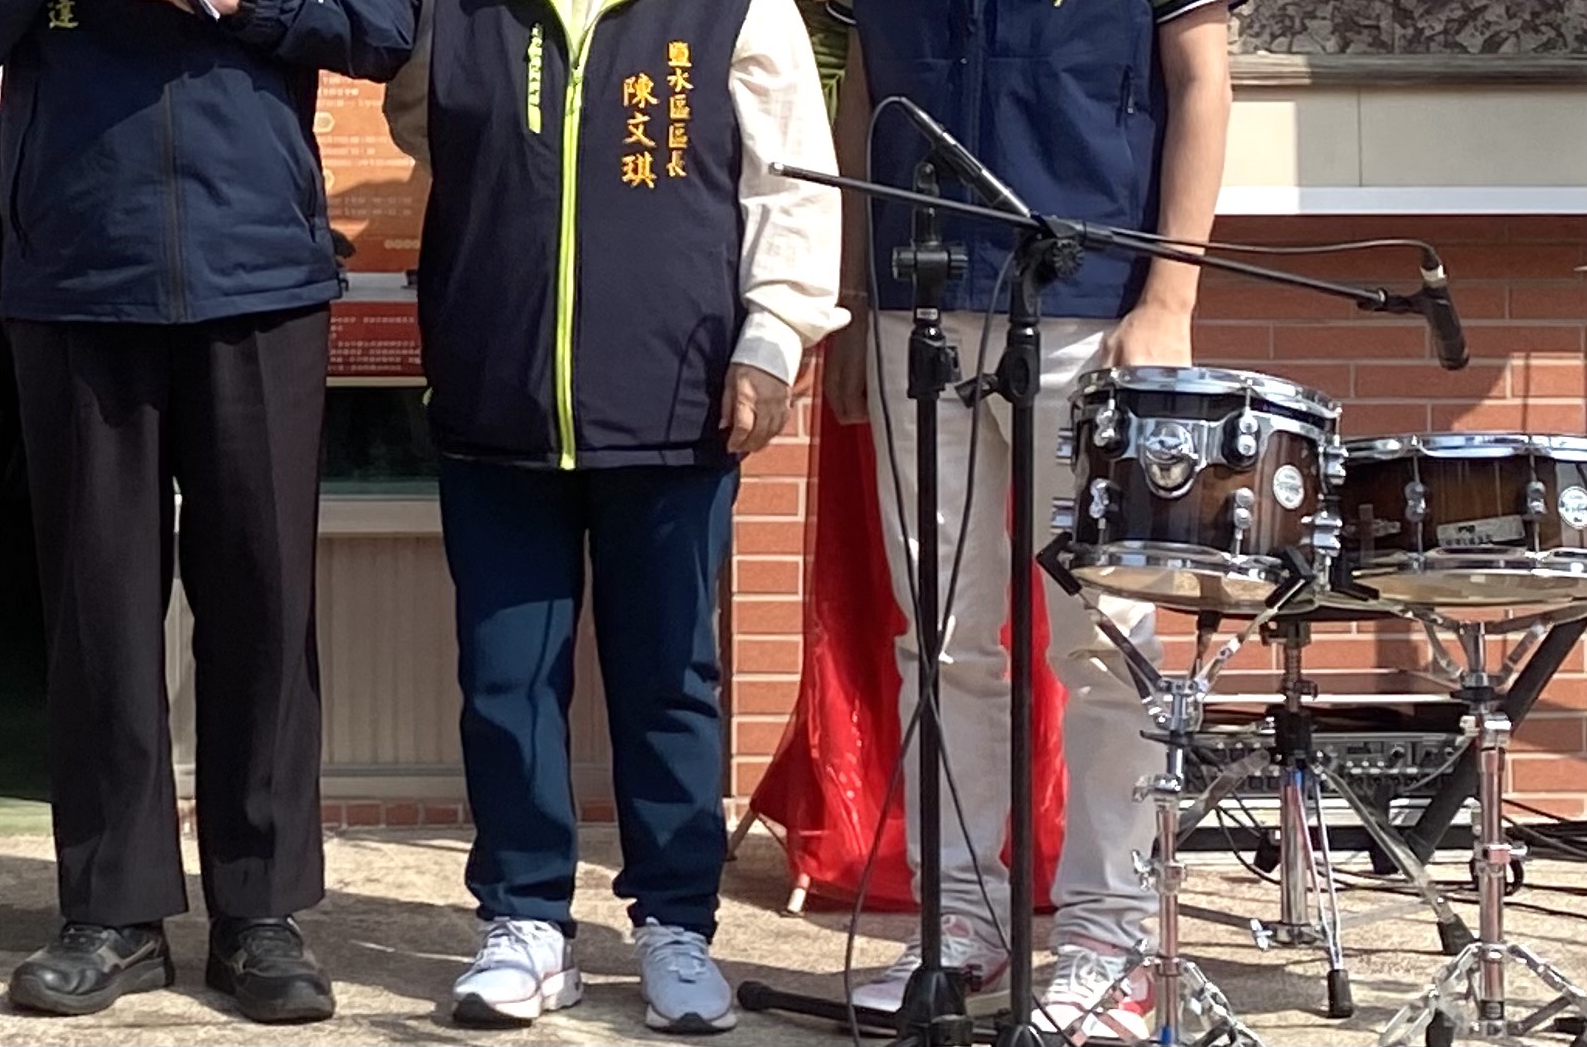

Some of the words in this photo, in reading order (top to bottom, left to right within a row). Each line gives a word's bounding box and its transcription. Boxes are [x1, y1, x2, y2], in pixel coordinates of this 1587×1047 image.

[621, 72, 660, 190] 陳文琪
[666, 40, 695, 179] 鹽水區區長
